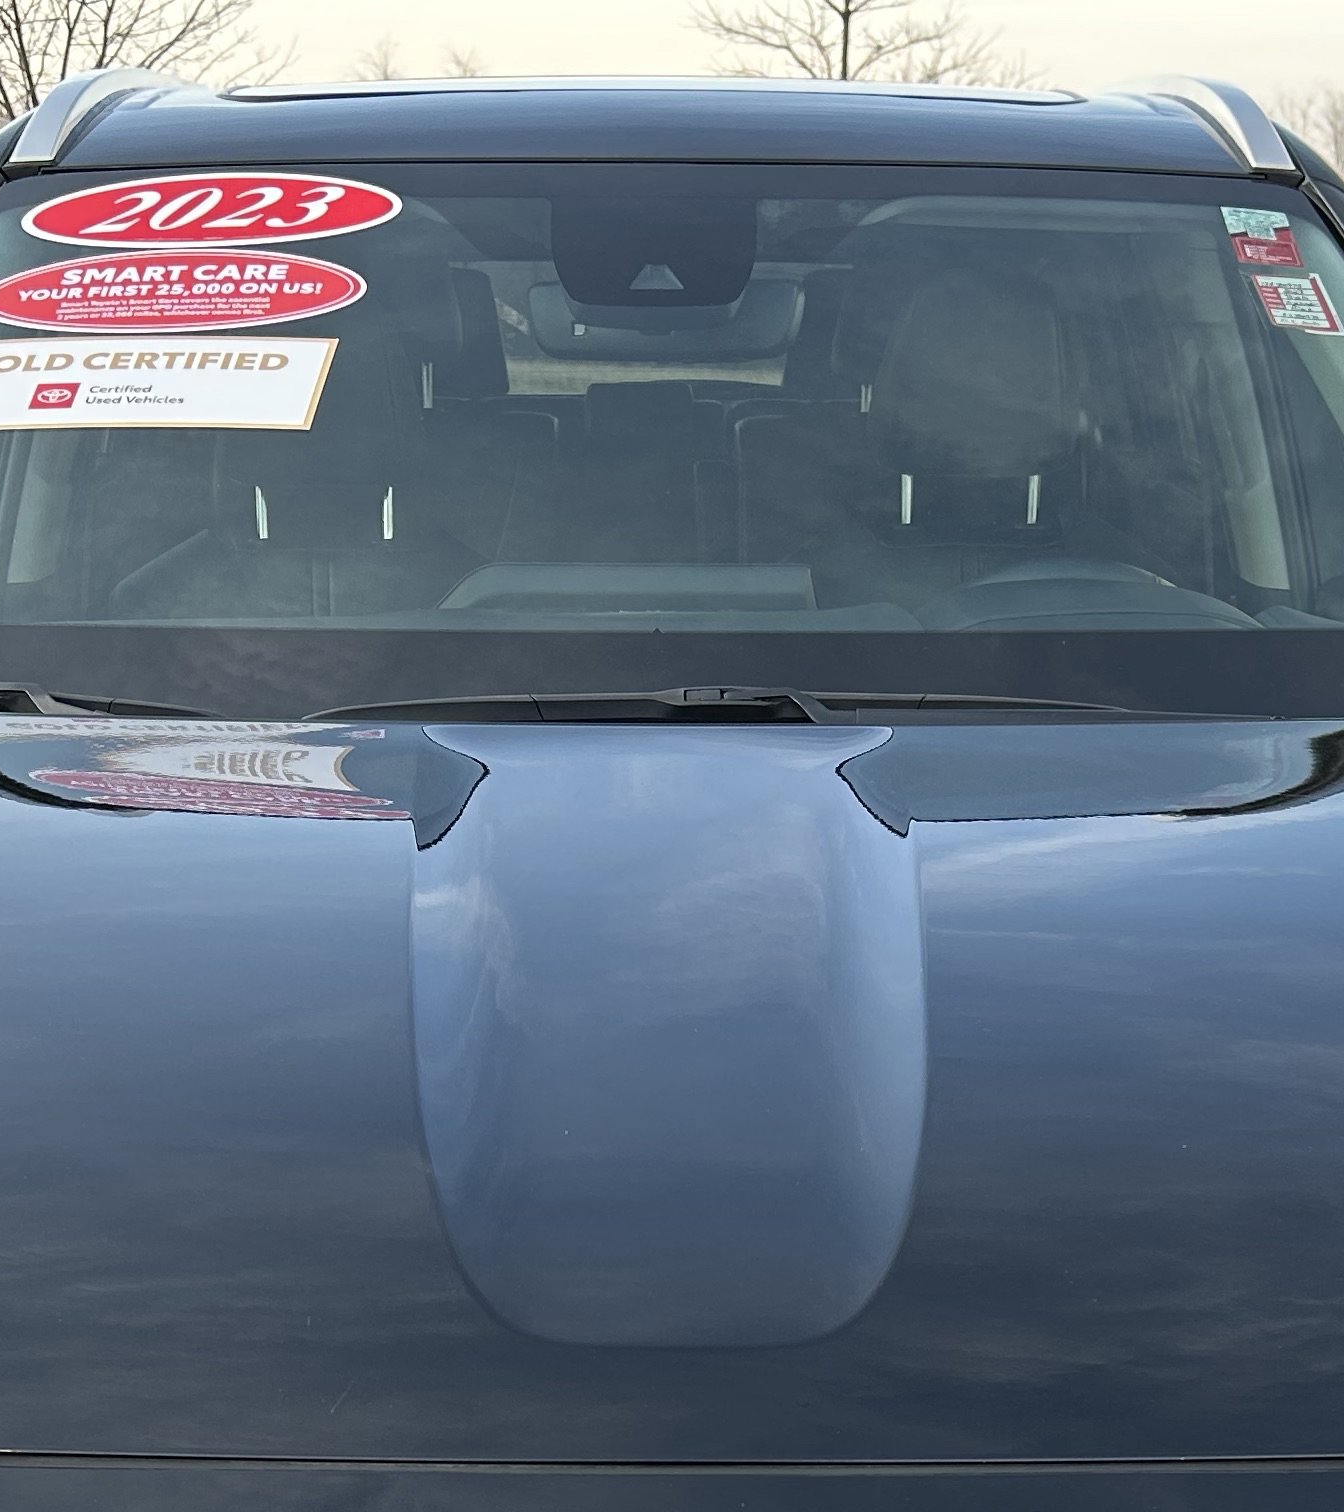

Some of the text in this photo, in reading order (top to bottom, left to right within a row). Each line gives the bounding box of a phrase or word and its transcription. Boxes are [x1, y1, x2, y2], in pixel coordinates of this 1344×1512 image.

[78, 186, 346, 234] 2023
[60, 263, 289, 285] SMART CARE
[18, 281, 323, 302] YOUR FIRST 25,000 ON US!
[83, 352, 289, 371] CERTIFIED
[89, 384, 153, 394] Certified
[85, 395, 184, 405] Used Vehicles
